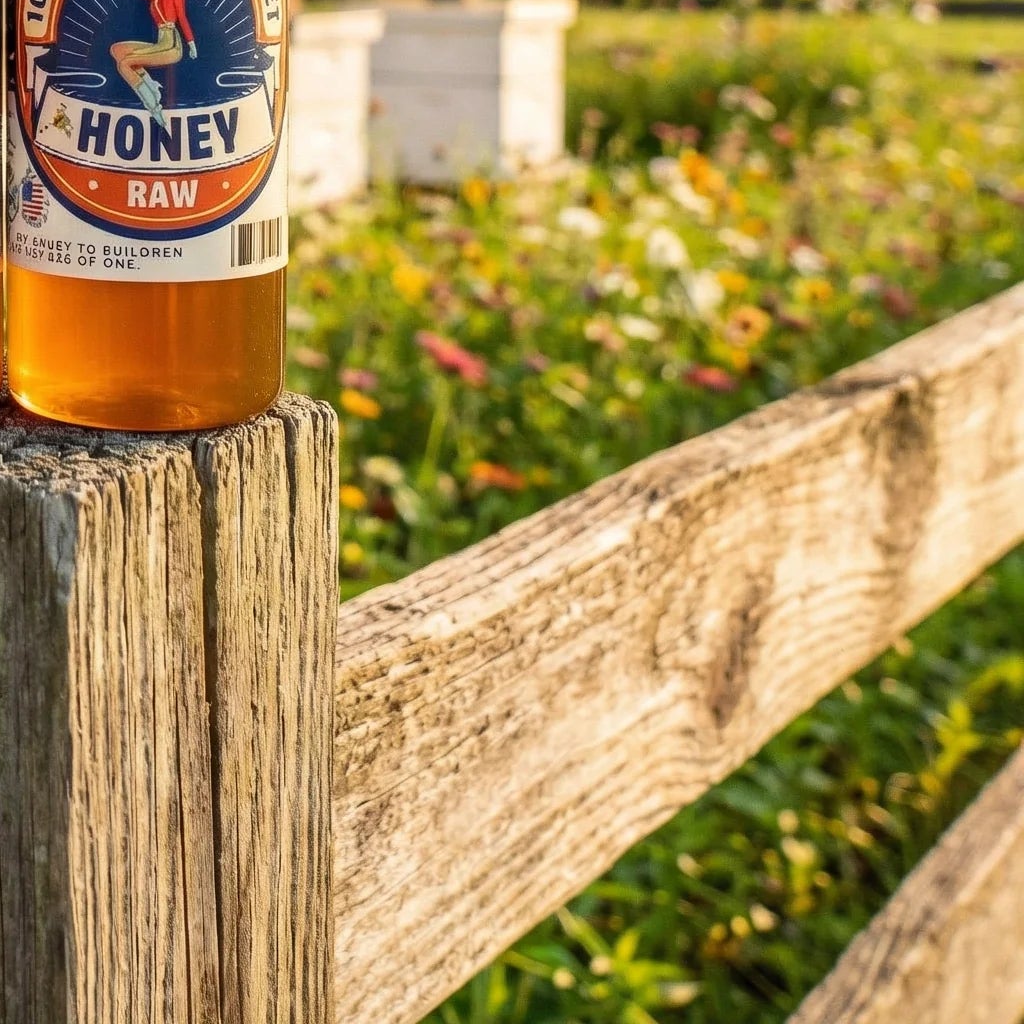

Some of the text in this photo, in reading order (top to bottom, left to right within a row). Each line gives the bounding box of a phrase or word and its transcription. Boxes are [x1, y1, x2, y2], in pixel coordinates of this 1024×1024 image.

[77, 107, 239, 162] HONEY
[127, 179, 199, 209] RAW
[77, 243, 96, 255] TO
[77, 256, 97, 267] OF
[103, 258, 141, 270] ONE.
